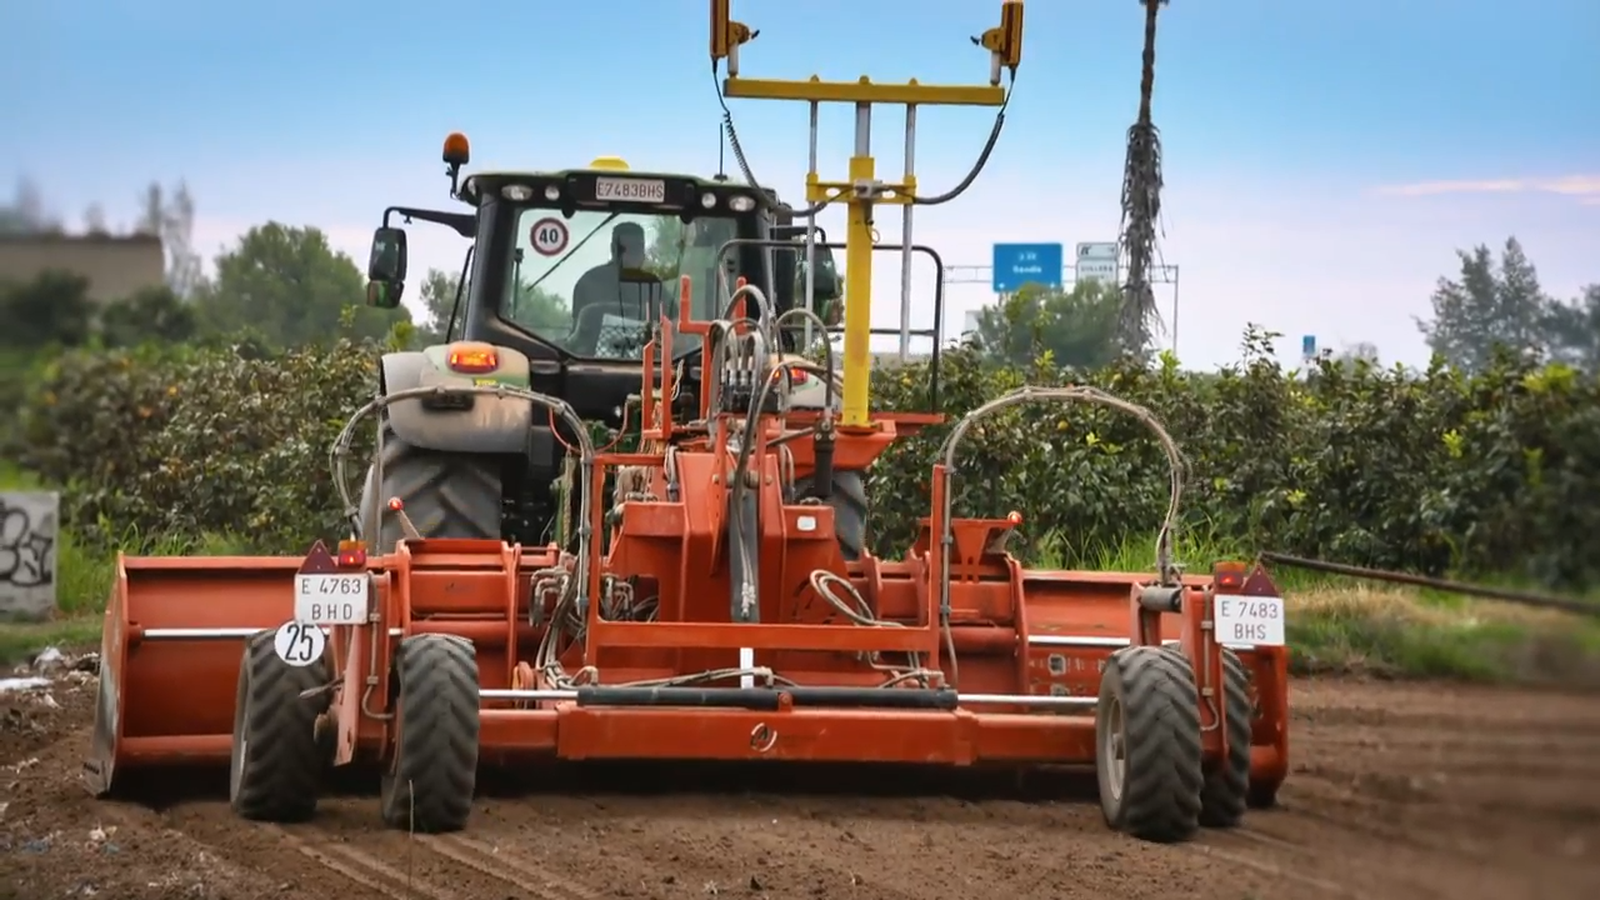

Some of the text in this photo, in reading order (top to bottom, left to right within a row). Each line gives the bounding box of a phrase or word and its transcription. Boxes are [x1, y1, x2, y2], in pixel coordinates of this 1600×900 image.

[597, 181, 663, 199] E7483BHS
[539, 228, 559, 244] 40
[301, 578, 361, 595] E 4763
[1221, 600, 1278, 619] E 7483
[1234, 623, 1267, 640] BHS
[284, 624, 315, 662] 25
